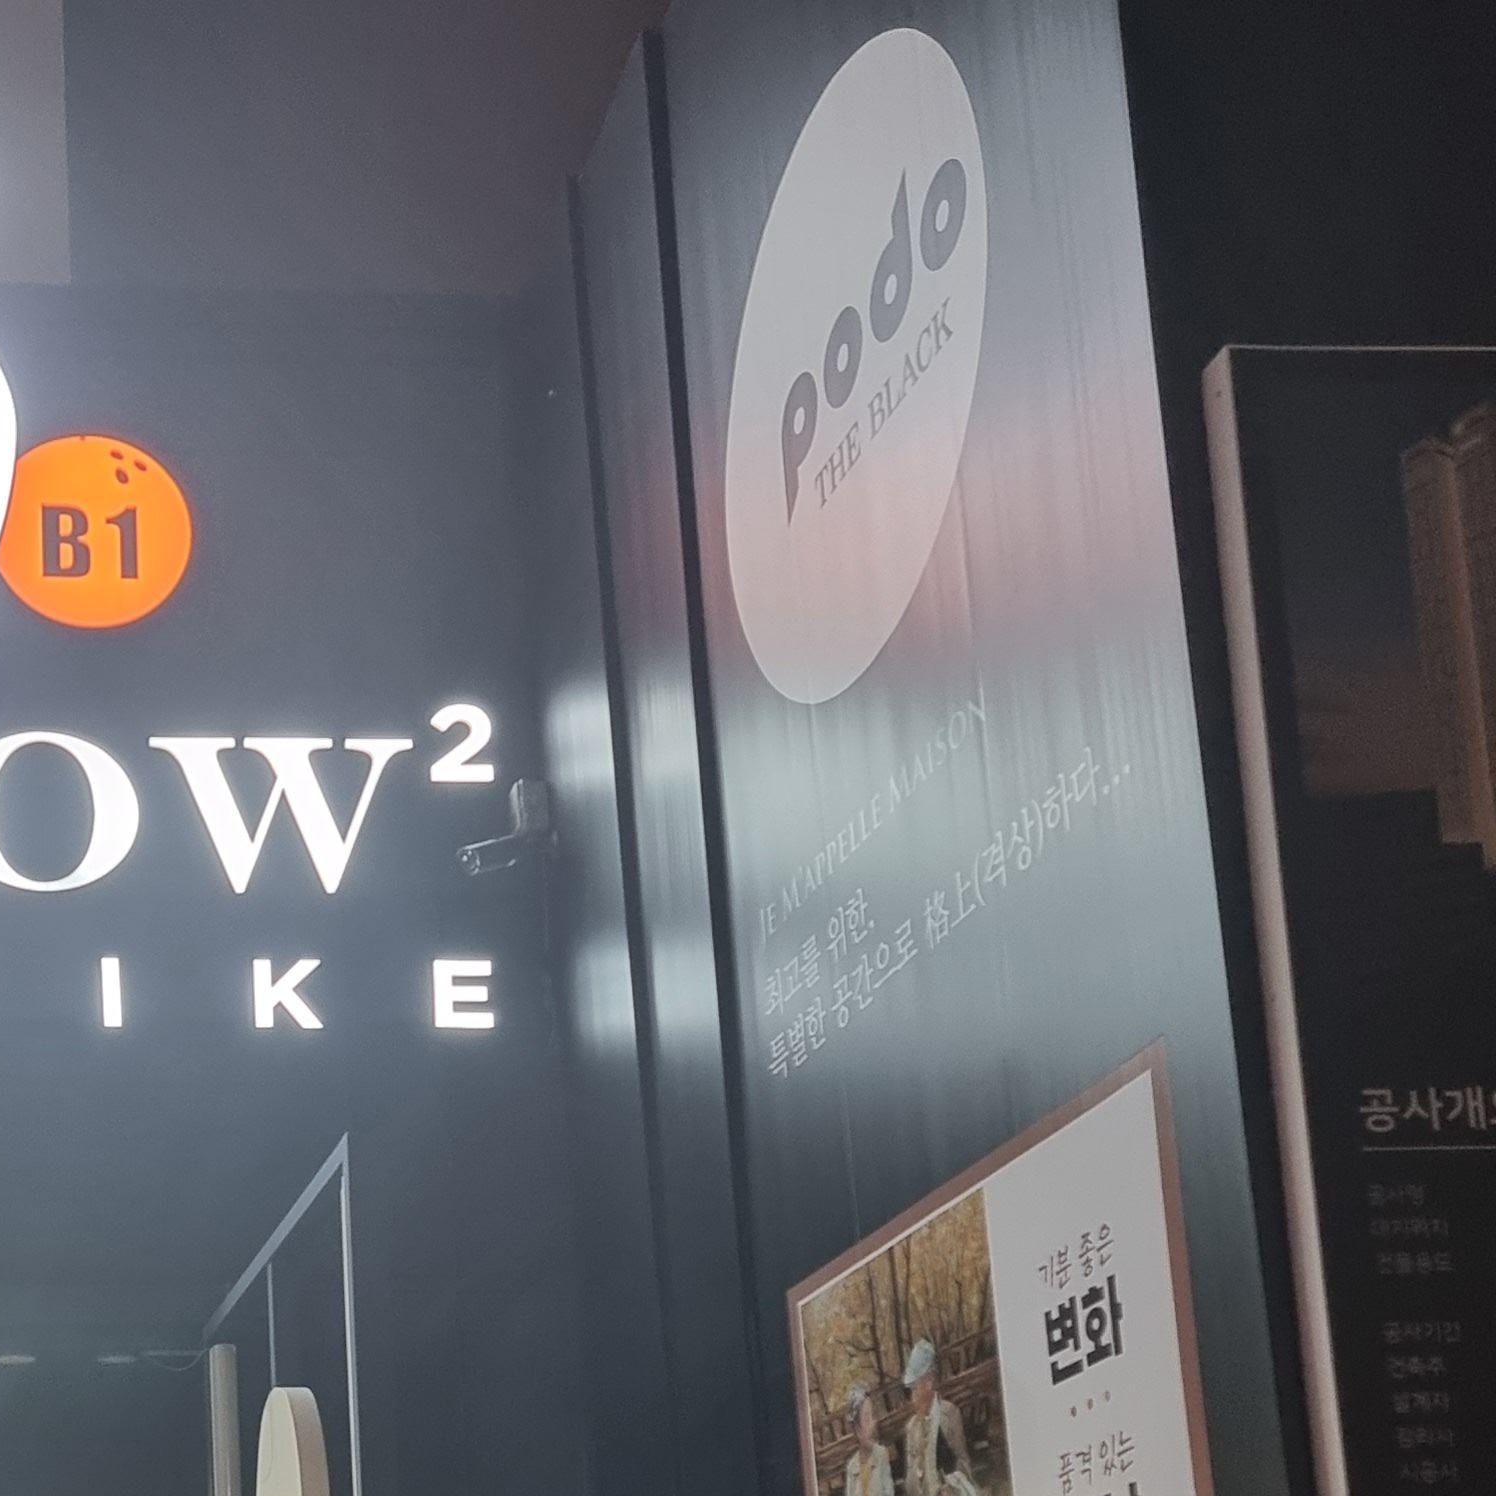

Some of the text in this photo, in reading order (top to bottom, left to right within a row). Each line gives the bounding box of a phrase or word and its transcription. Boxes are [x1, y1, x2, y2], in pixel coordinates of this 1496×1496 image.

[781, 157, 967, 528] podo
[814, 296, 954, 509] THE BLACK
[41, 503, 139, 580] B1
[765, 933, 823, 1016] 최고를
[767, 996, 827, 1079] 특별한
[831, 917, 919, 1029] 공간으로
[1359, 1084, 1496, 1134] 공사개
[1037, 1222, 1115, 1290] 기분 좋은
[1043, 1273, 1124, 1387] 변화
[1058, 1429, 1136, 1496] 품격 있는
